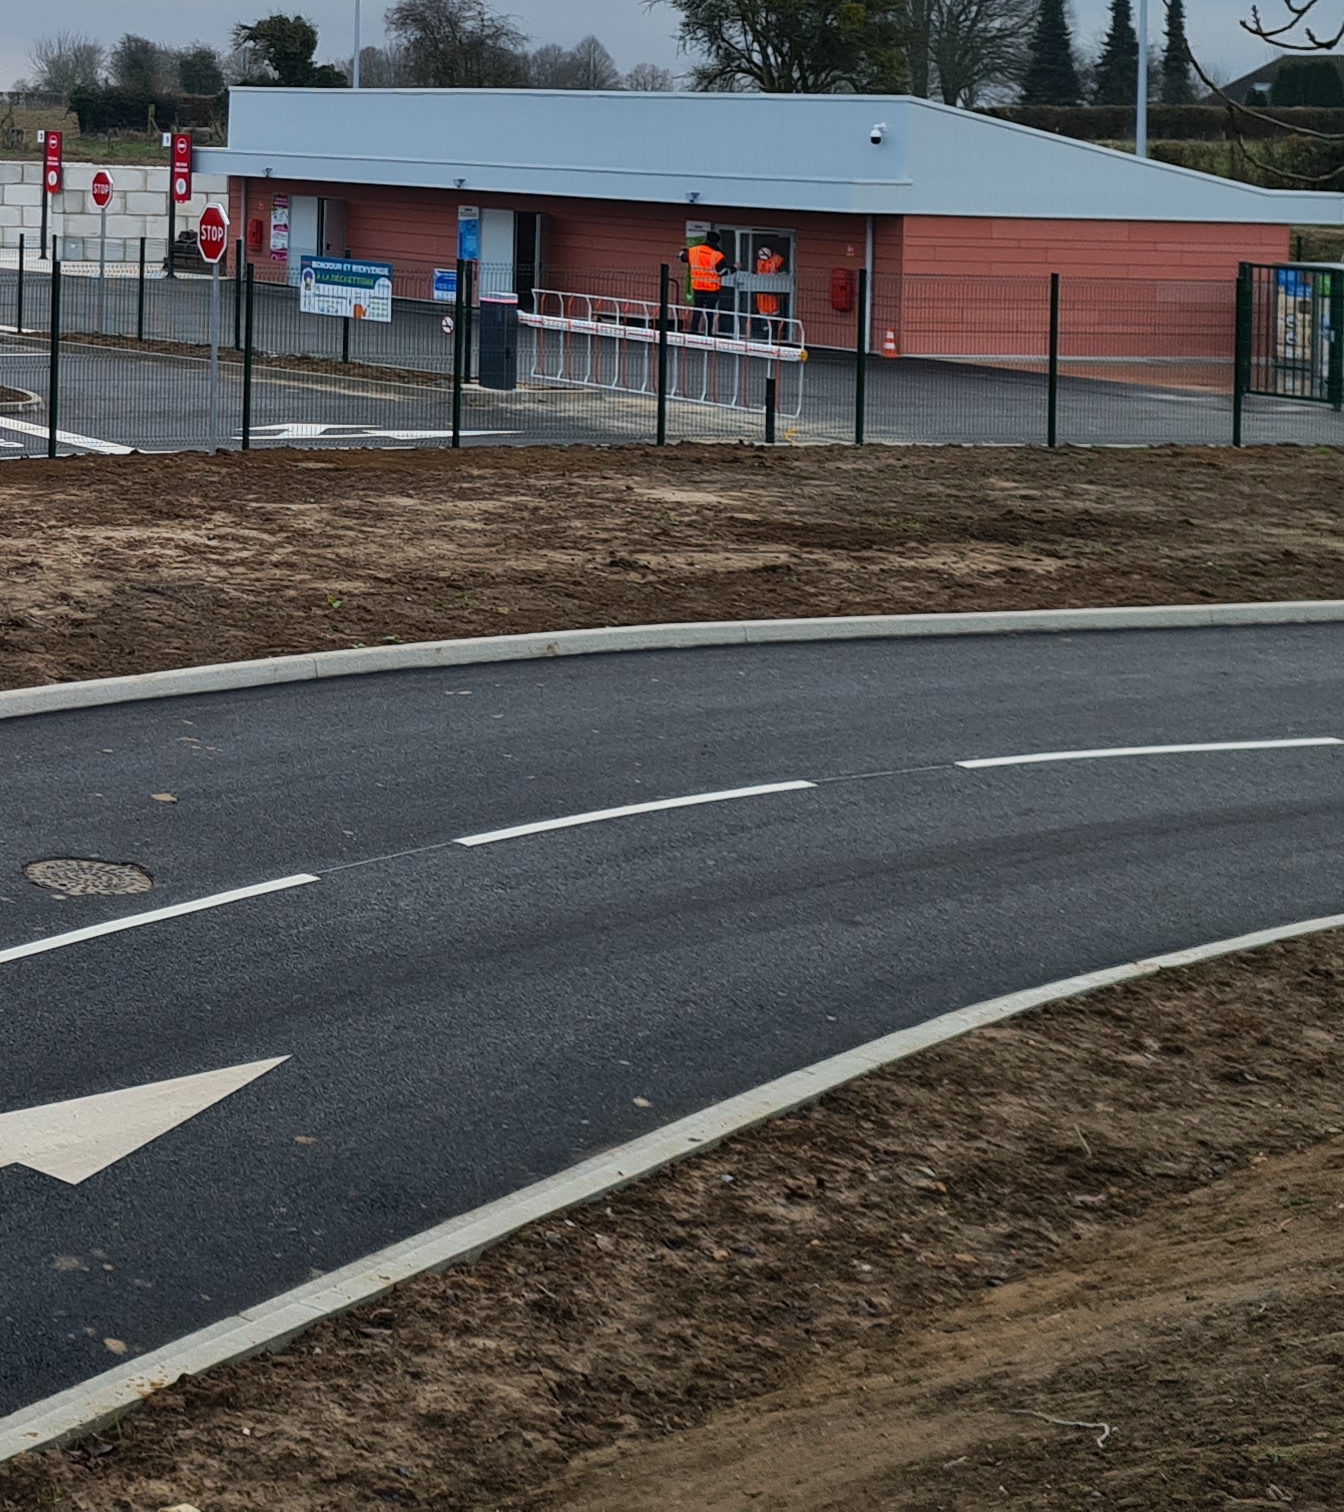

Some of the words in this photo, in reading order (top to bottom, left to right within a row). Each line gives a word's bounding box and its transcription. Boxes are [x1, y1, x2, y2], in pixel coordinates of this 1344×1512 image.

[93, 183, 110, 195] STOP
[200, 224, 224, 242] STOP
[312, 260, 343, 270] BONJOUR
